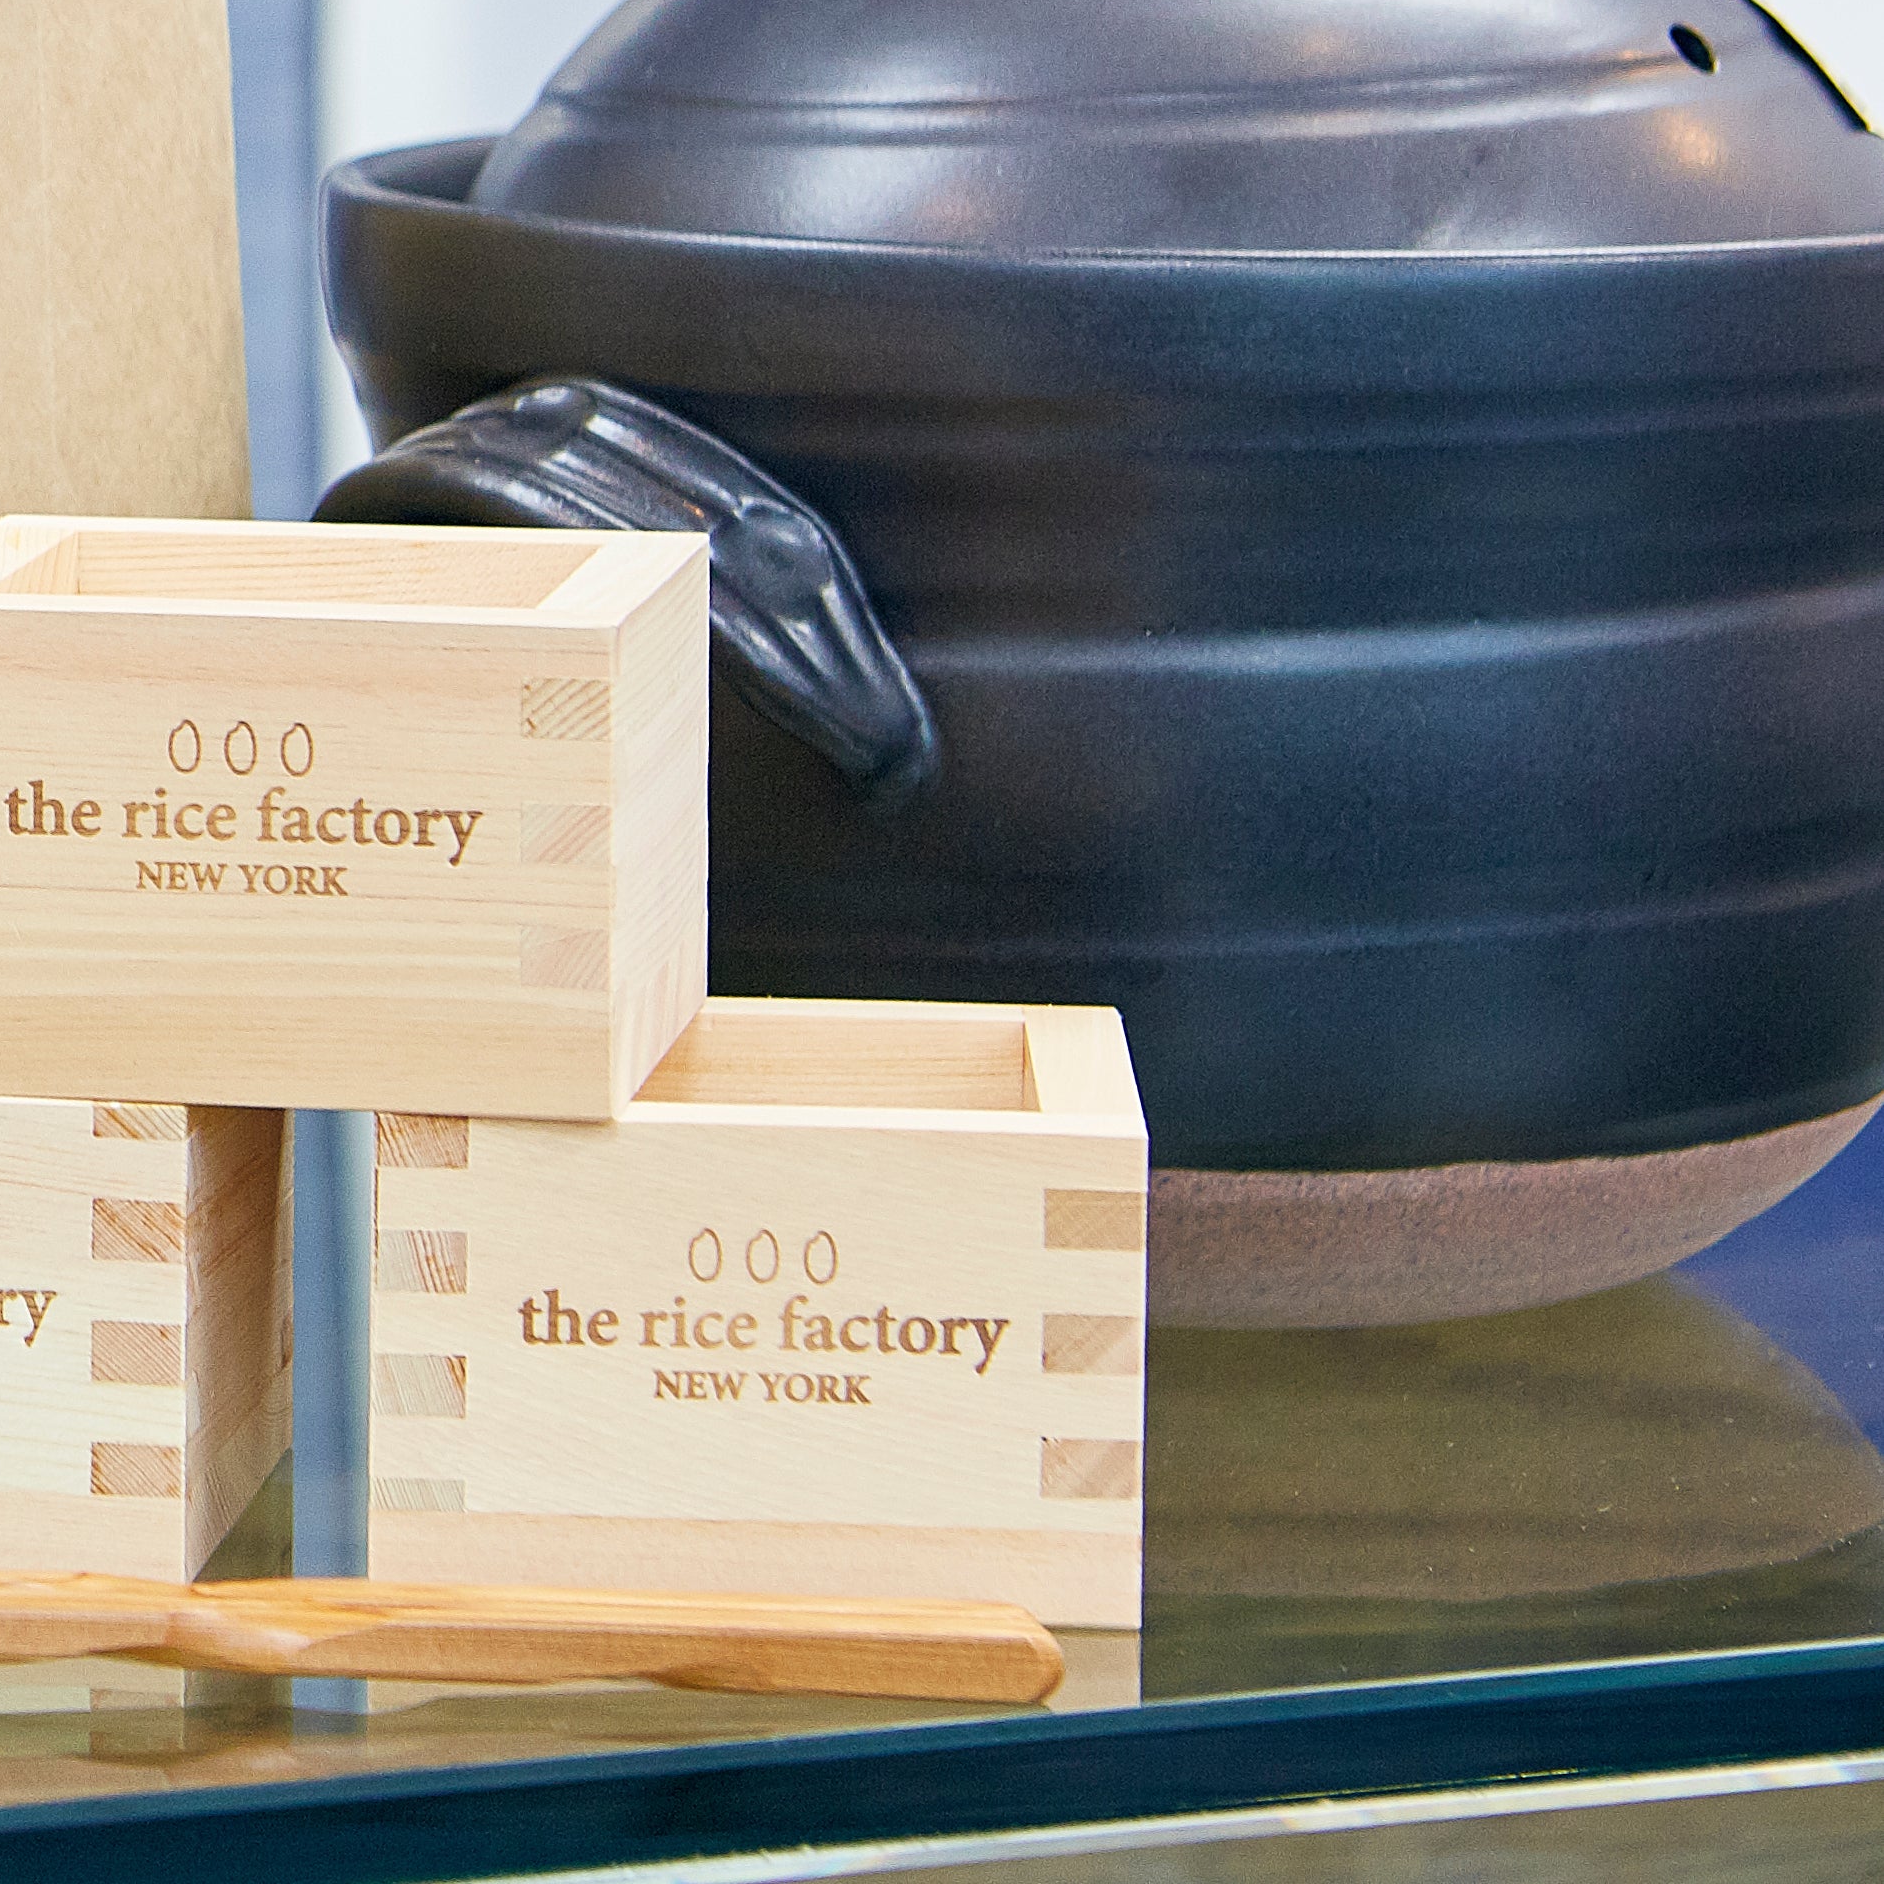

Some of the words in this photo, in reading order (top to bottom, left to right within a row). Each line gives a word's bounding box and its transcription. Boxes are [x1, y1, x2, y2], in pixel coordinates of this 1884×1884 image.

[4, 779, 102, 838] the
[122, 787, 236, 841] rice
[256, 787, 483, 866] factory
[135, 861, 227, 892] NEW
[238, 863, 349, 897] YORK
[518, 1288, 620, 1348] the
[639, 1296, 758, 1350] rice
[778, 1295, 1010, 1376] factory
[653, 1369, 748, 1400] NEW
[757, 1371, 872, 1406] YORK
